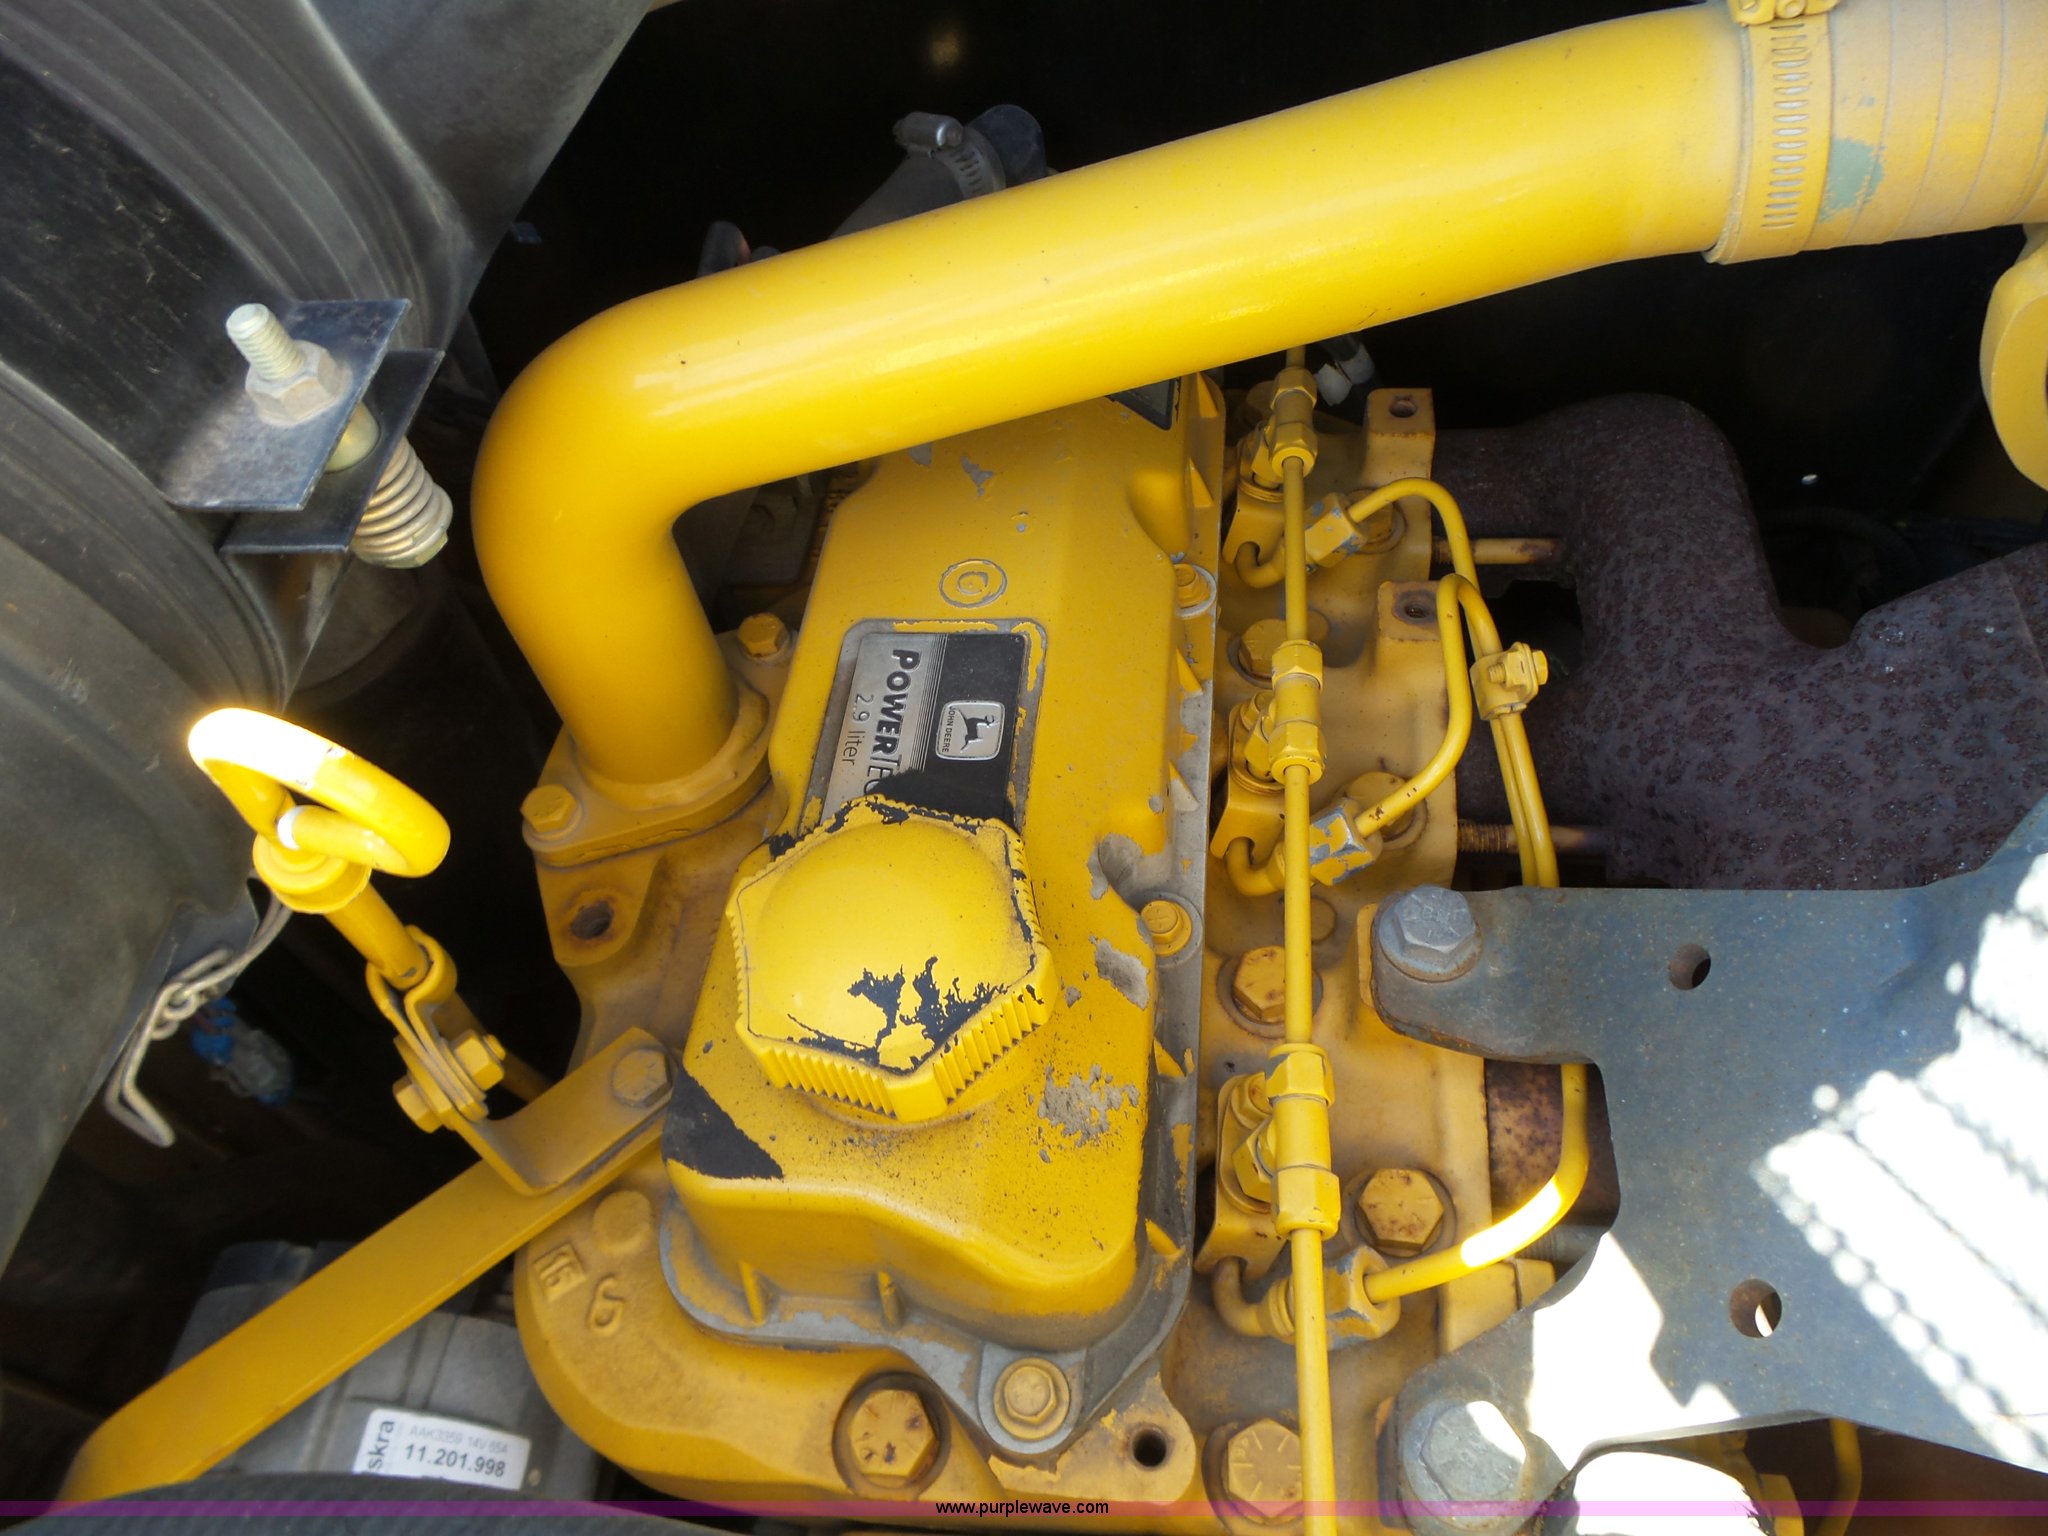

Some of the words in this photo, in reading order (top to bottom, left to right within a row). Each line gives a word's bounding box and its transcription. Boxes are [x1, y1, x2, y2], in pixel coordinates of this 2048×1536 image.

[851, 693, 874, 722] 2.9
[946, 705, 956, 726] JOHN
[841, 730, 866, 766] liter
[941, 728, 953, 753] DEERE
[405, 1443, 506, 1478] 11.201.998
